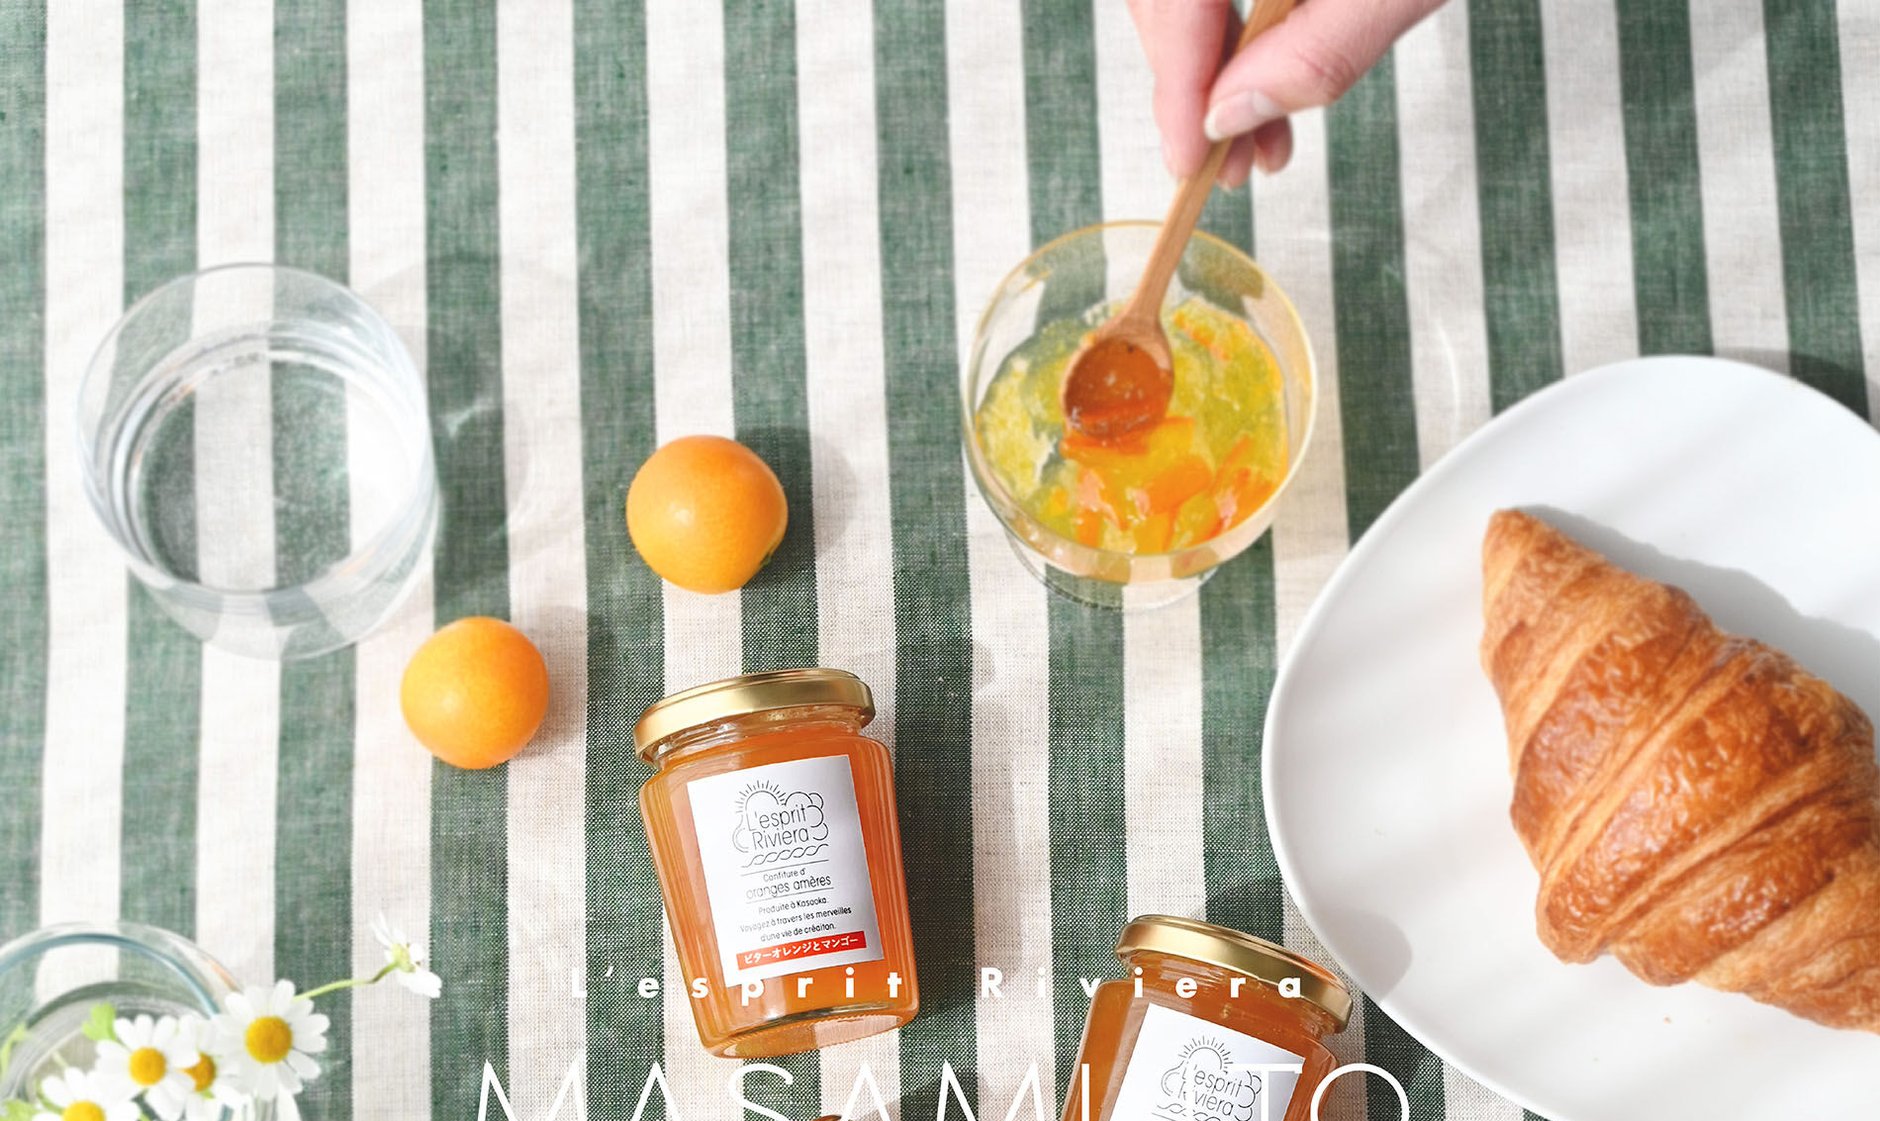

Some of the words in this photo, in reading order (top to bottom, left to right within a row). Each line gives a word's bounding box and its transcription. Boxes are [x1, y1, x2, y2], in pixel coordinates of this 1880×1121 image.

[745, 803, 806, 831] L'esprit
[752, 827, 809, 850] Riviera
[763, 869, 798, 883] Confiture
[746, 882, 790, 899] oranges
[793, 875, 832, 891] amères
[758, 902, 790, 915] Produite
[776, 914, 803, 925] travers
[815, 907, 852, 918] merveilles
[780, 930, 793, 938] vie
[792, 927, 803, 935] de
[743, 935, 859, 964] ビターオレンジとマンゴー
